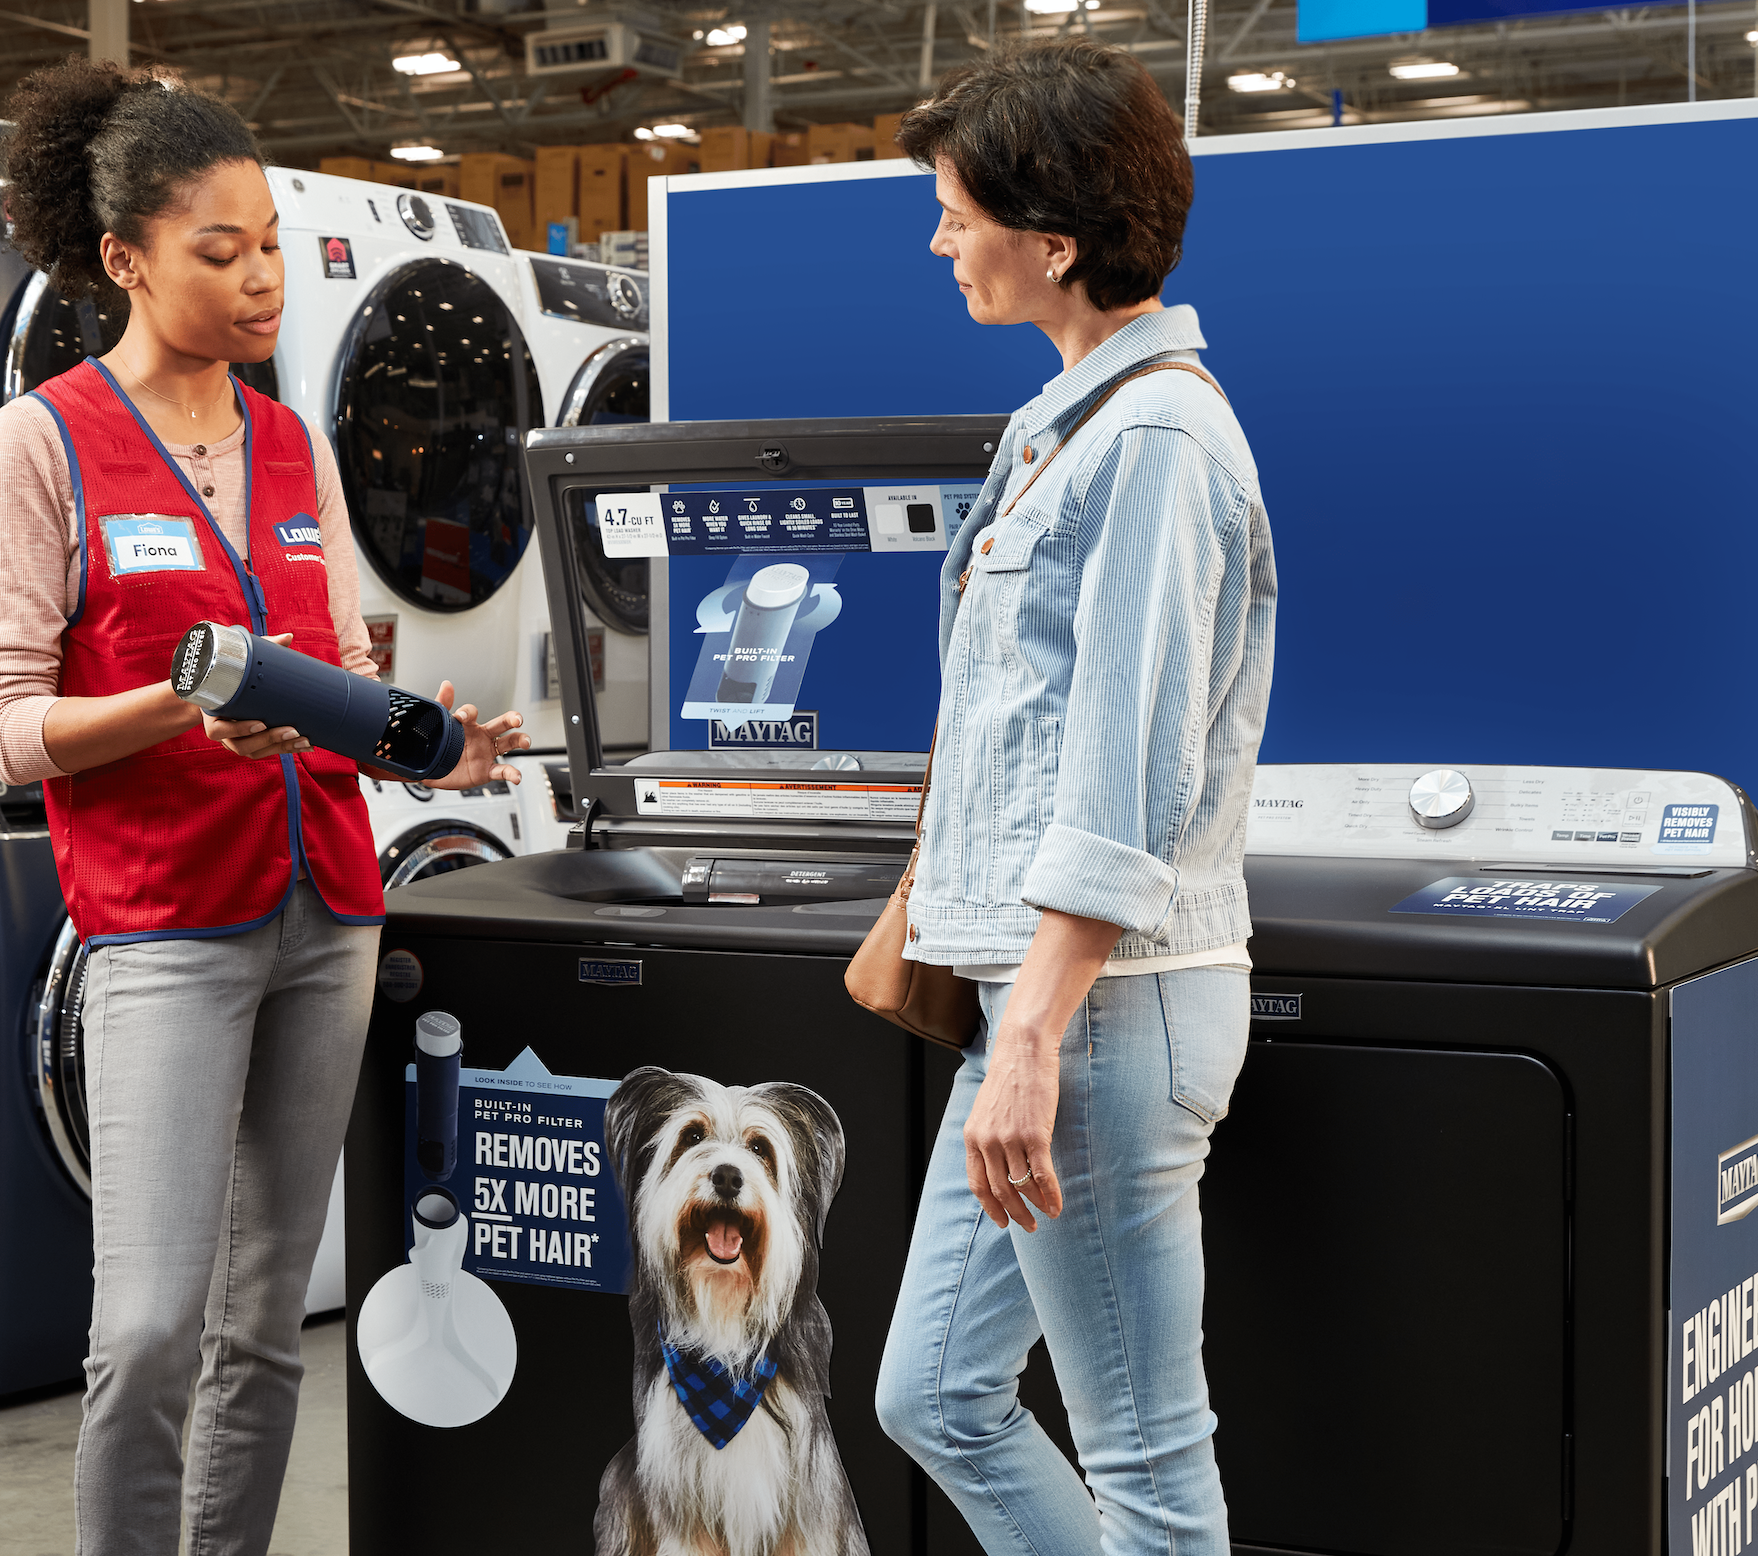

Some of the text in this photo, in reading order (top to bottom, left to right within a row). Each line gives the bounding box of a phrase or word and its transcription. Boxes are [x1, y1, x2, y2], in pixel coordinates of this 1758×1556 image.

[646, 516, 654, 525] FT
[133, 544, 177, 556] Fiona
[177, 630, 198, 690] MAYTAG
[736, 654, 758, 662] PRO
[714, 721, 812, 742] MAYTAG
[1254, 799, 1304, 808] MAYTAG
[1672, 807, 1710, 817] VISIBLY
[1664, 817, 1714, 828] REMOVES
[1663, 828, 1709, 838] PET HAIR
[1450, 886, 1616, 900] LOADS OF
[1492, 881, 1600, 891] TRAPS
[1441, 894, 1598, 909] PET HAIR
[582, 963, 638, 979] MAYTAG
[1251, 999, 1297, 1014] AYTAG
[474, 1099, 532, 1112] BUILT-IN
[474, 1110, 583, 1128] PET PRO FILTER
[475, 1132, 601, 1177] REMOVES
[1721, 1154, 1758, 1204] MAYTA
[474, 1177, 596, 1222] 5X MORE
[475, 1223, 523, 1260] PET
[1686, 1395, 1724, 1501] FOR
[1692, 1462, 1758, 1556] WITH P
